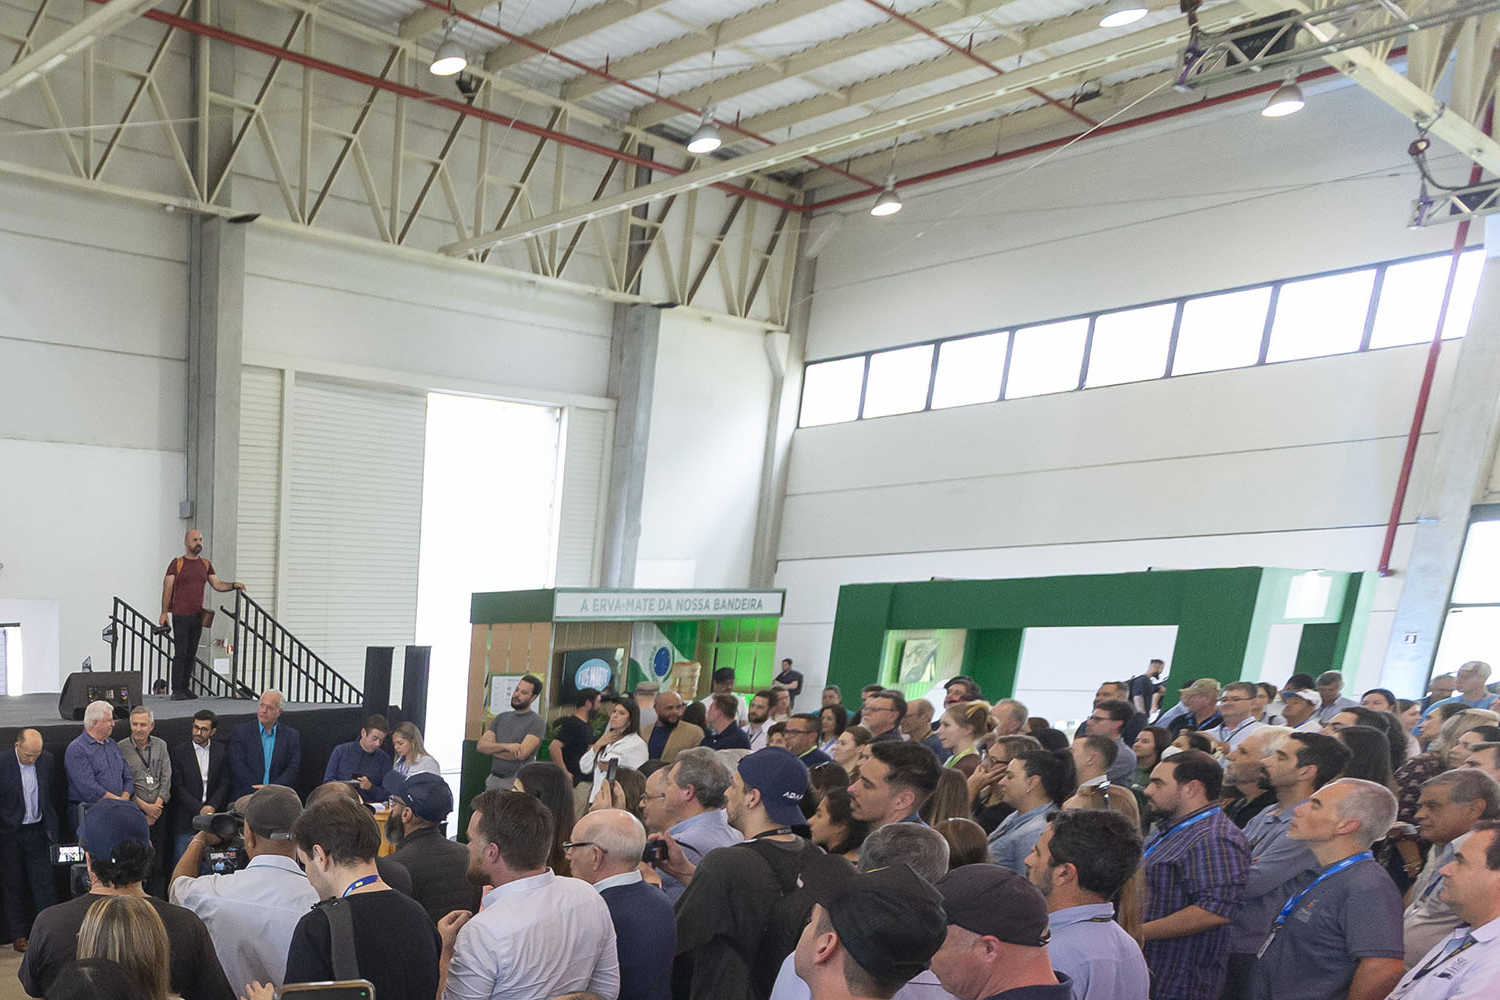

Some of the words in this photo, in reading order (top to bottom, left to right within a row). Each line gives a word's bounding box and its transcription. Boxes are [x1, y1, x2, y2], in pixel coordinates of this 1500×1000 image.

[580, 599, 589, 612] A
[592, 598, 654, 612] ERVA-MATE
[658, 598, 673, 611] DA
[675, 598, 710, 611] NOSSA
[713, 597, 763, 611] BANDEIRA
